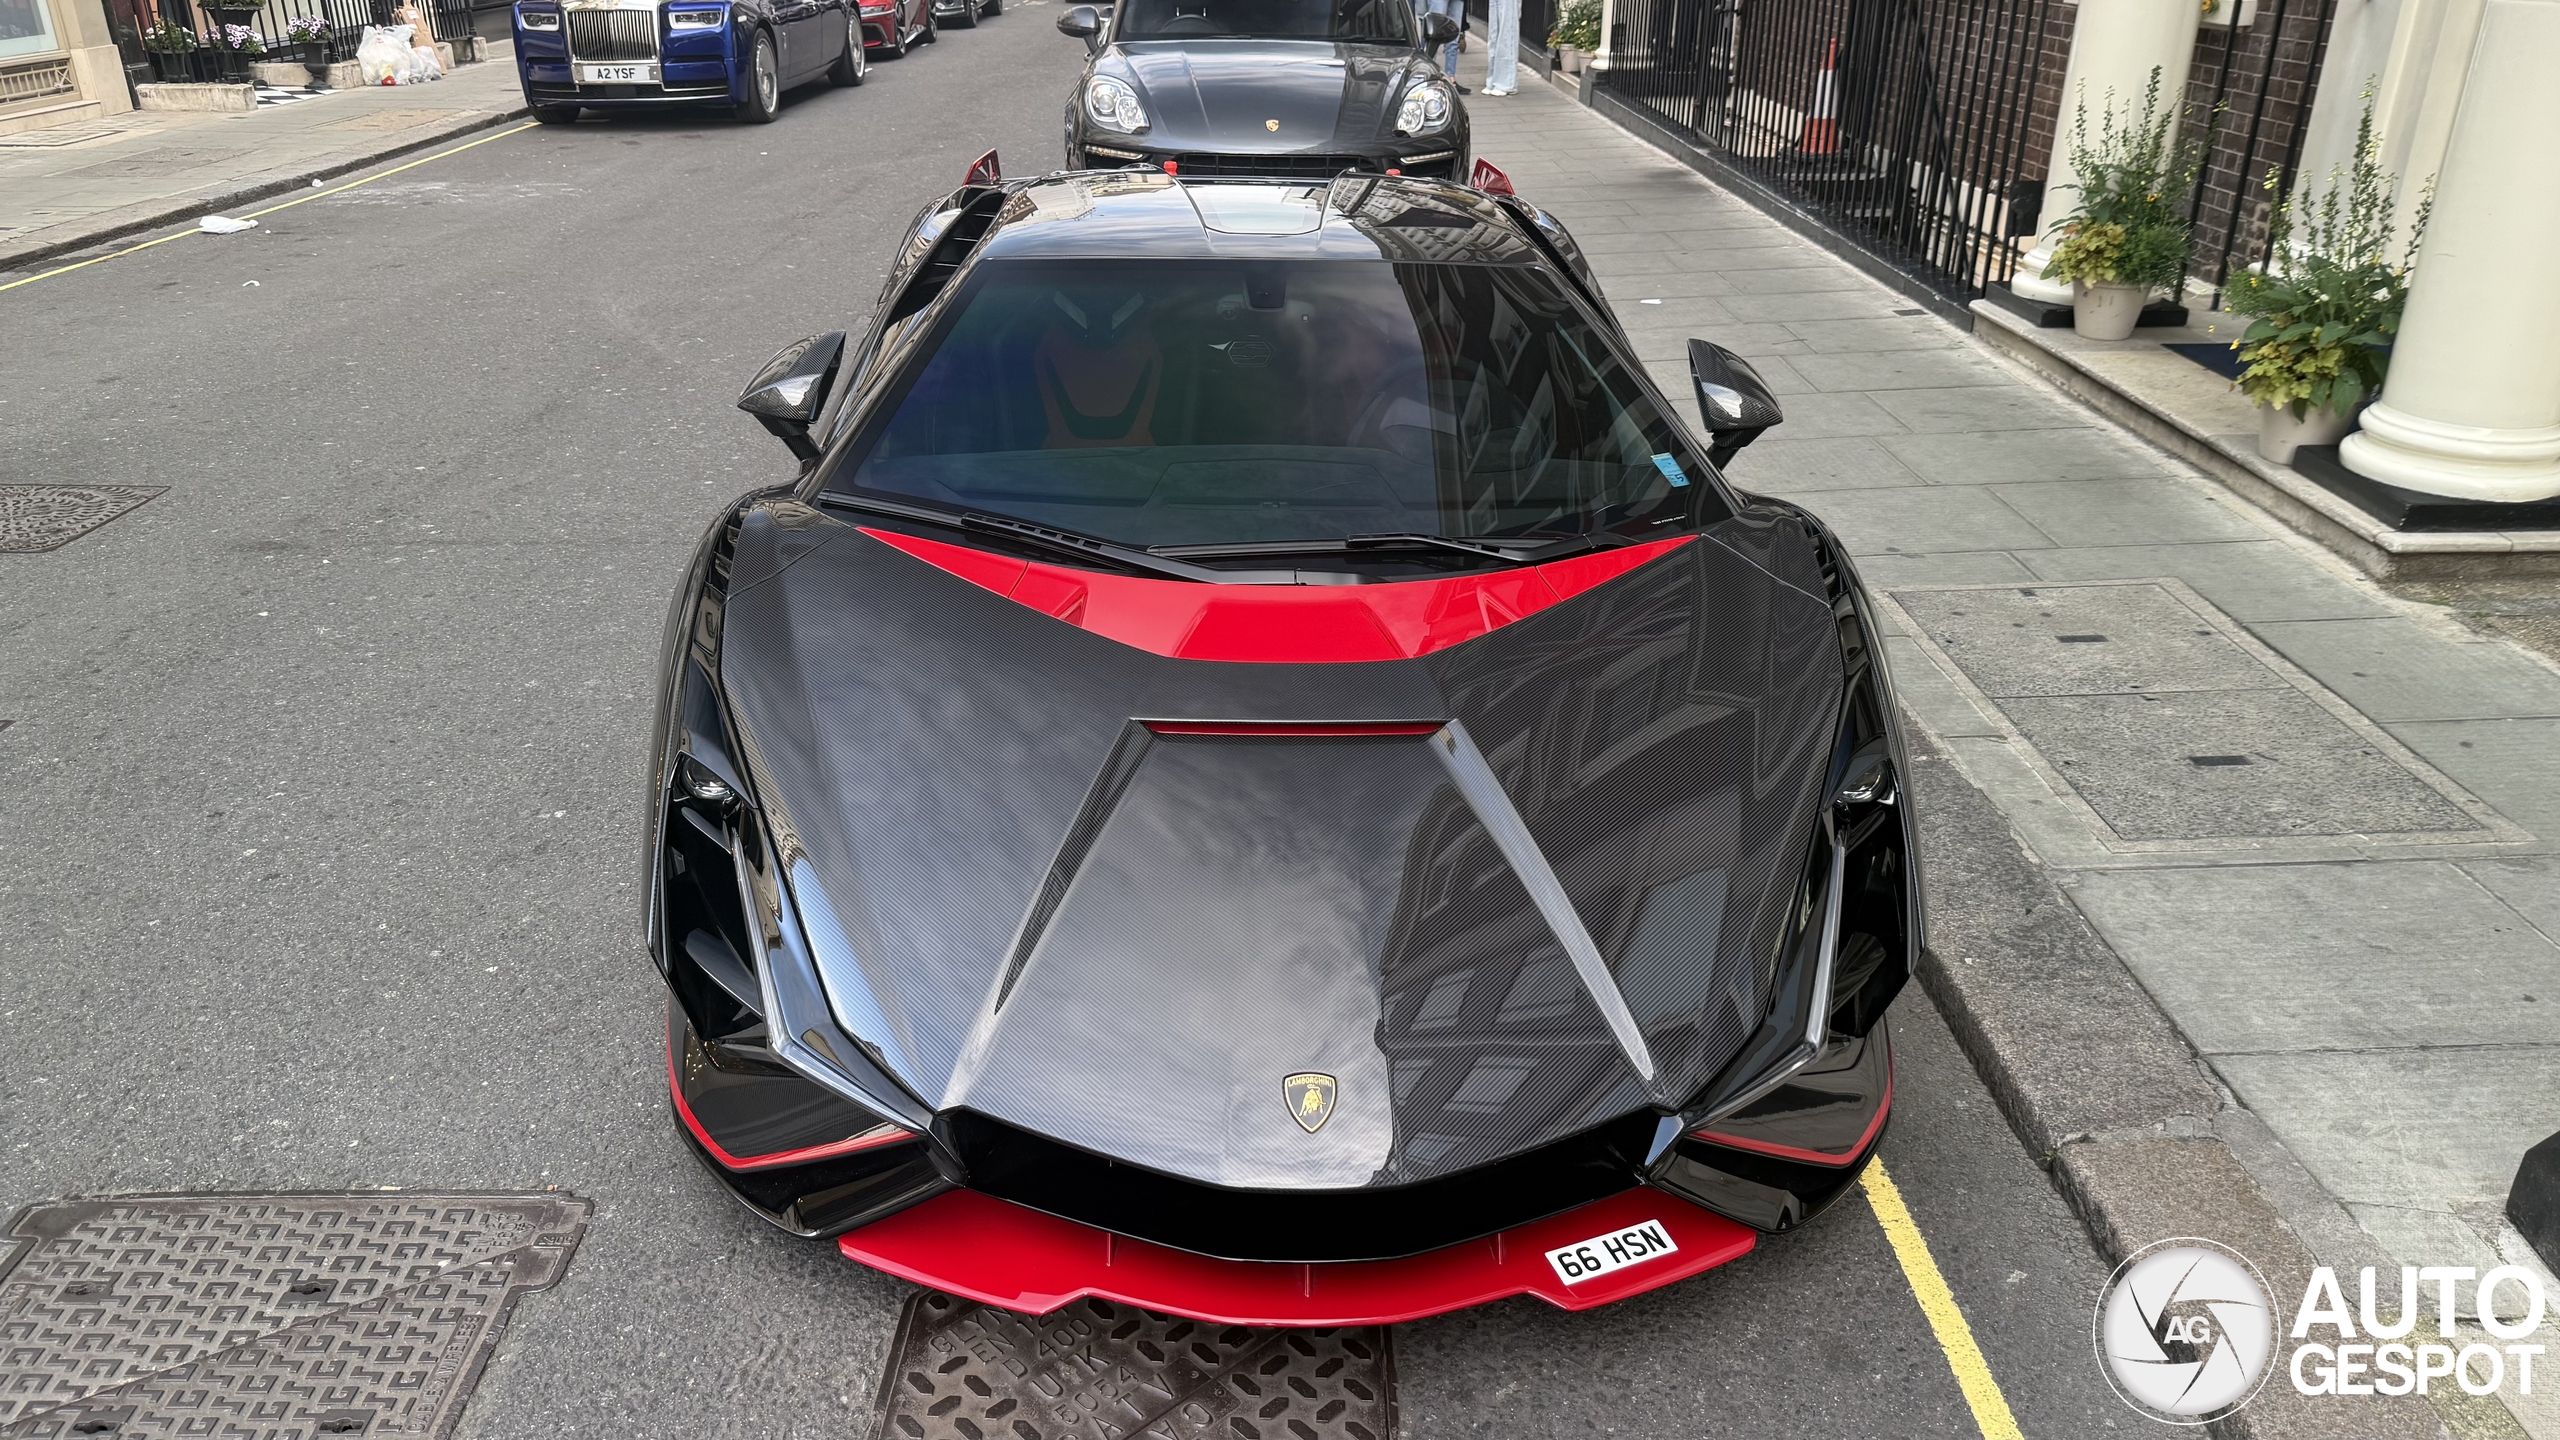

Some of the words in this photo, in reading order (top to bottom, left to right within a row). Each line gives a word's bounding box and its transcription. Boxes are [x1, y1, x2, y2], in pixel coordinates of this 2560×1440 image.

[597, 68, 611, 79] A2
[613, 67, 636, 79] YSF
[1287, 1075, 1333, 1088] LAMBORGHINI
[1557, 1246, 1602, 1278] 66
[1601, 1225, 1668, 1264] HSN
[1039, 1318, 1093, 1359] 400
[1054, 1365, 1140, 1425] 5054
